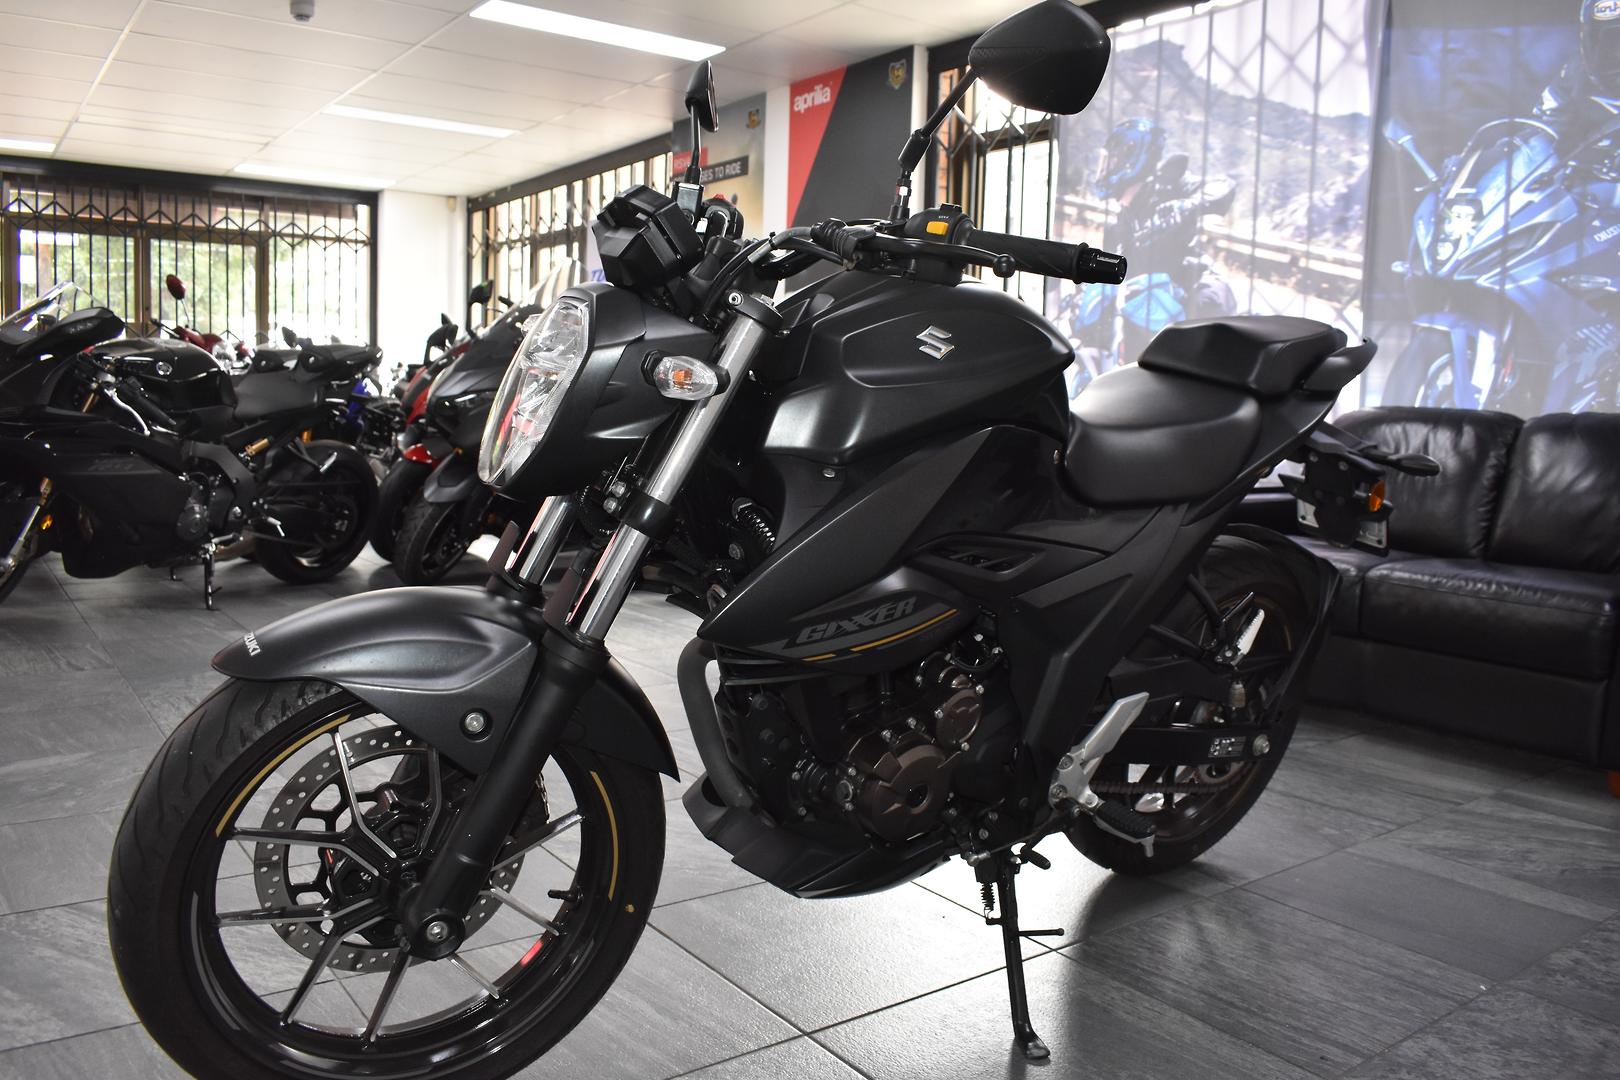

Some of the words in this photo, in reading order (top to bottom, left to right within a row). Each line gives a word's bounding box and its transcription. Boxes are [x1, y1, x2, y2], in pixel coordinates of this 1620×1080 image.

[794, 84, 830, 113] aprilia
[714, 166, 724, 179] TO
[725, 161, 741, 175] RIDE
[796, 597, 917, 643] GIXXER
